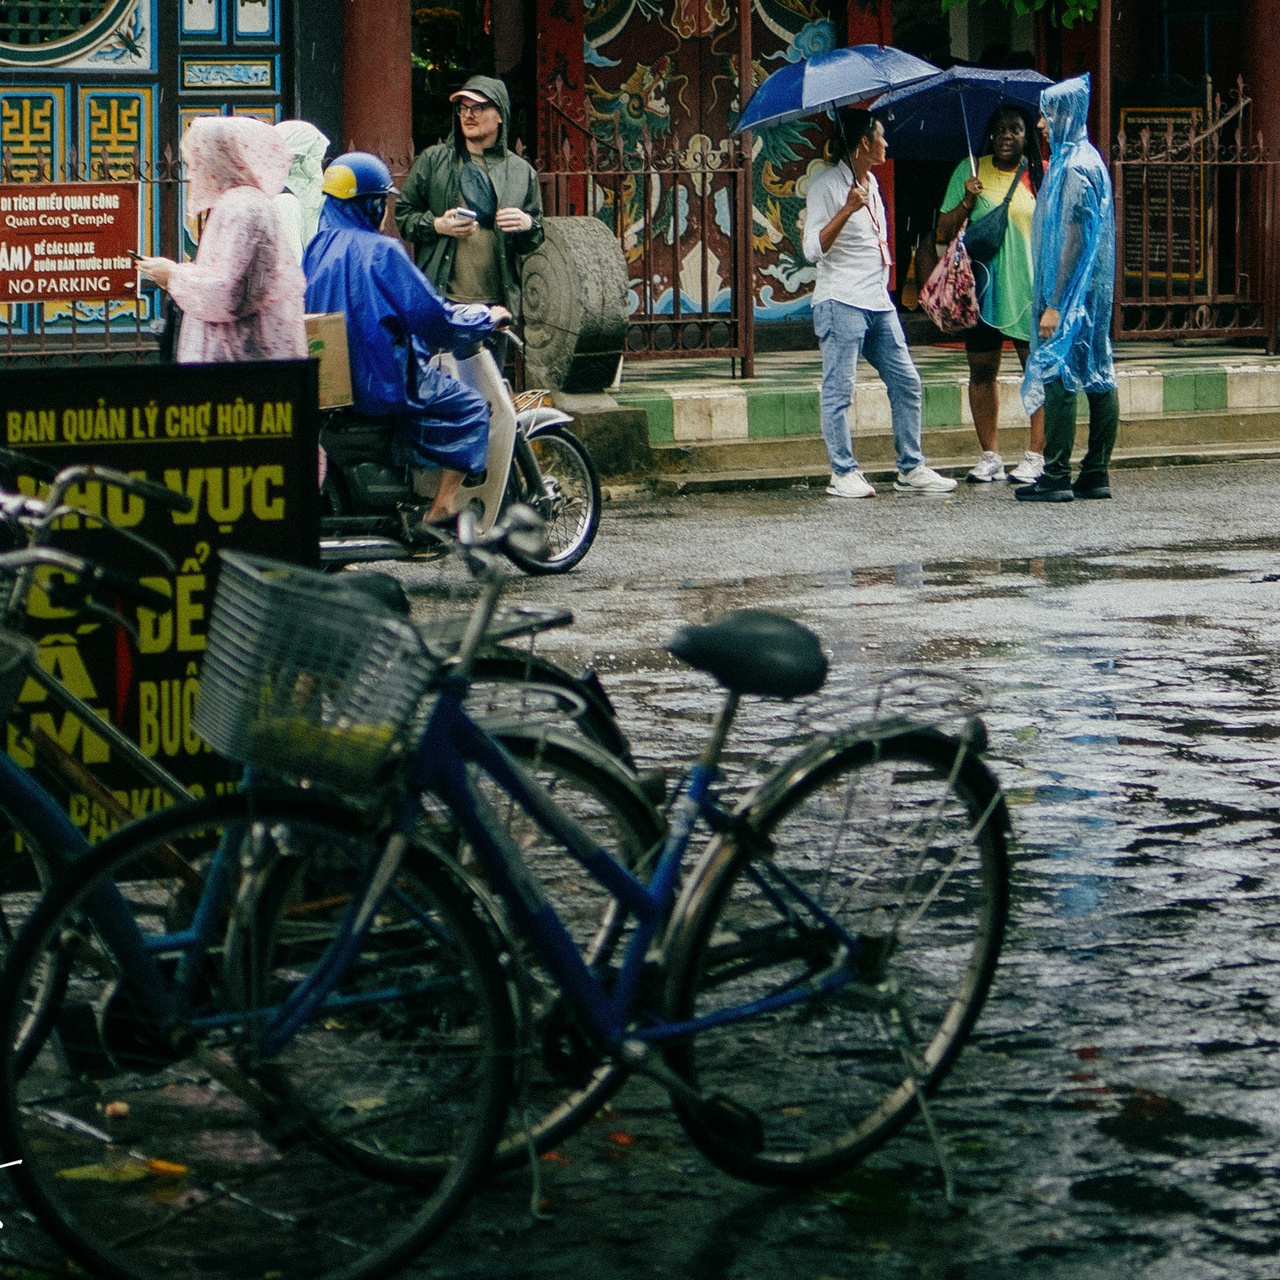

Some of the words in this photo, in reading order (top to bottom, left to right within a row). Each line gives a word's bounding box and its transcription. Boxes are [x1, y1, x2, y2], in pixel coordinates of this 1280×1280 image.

[13, 194, 37, 211] TÍCH
[64, 195, 91, 211] QUAN
[92, 192, 119, 210] CÔNG
[5, 214, 37, 228] Quan
[38, 213, 70, 228] Cong
[71, 213, 114, 227] Temple
[0, 241, 24, 271] ẤM
[84, 241, 95, 254] XE
[9, 278, 35, 294] NO
[38, 276, 111, 293] PARKING
[6, 409, 57, 443] BAN
[62, 397, 127, 444] QUẢN
[131, 399, 158, 439] LÝ
[164, 401, 213, 443] CHỢ
[216, 396, 256, 441] HỘI
[260, 401, 293, 434] AN
[163, 464, 286, 534] VỰC
[138, 660, 213, 759] BUÔ
